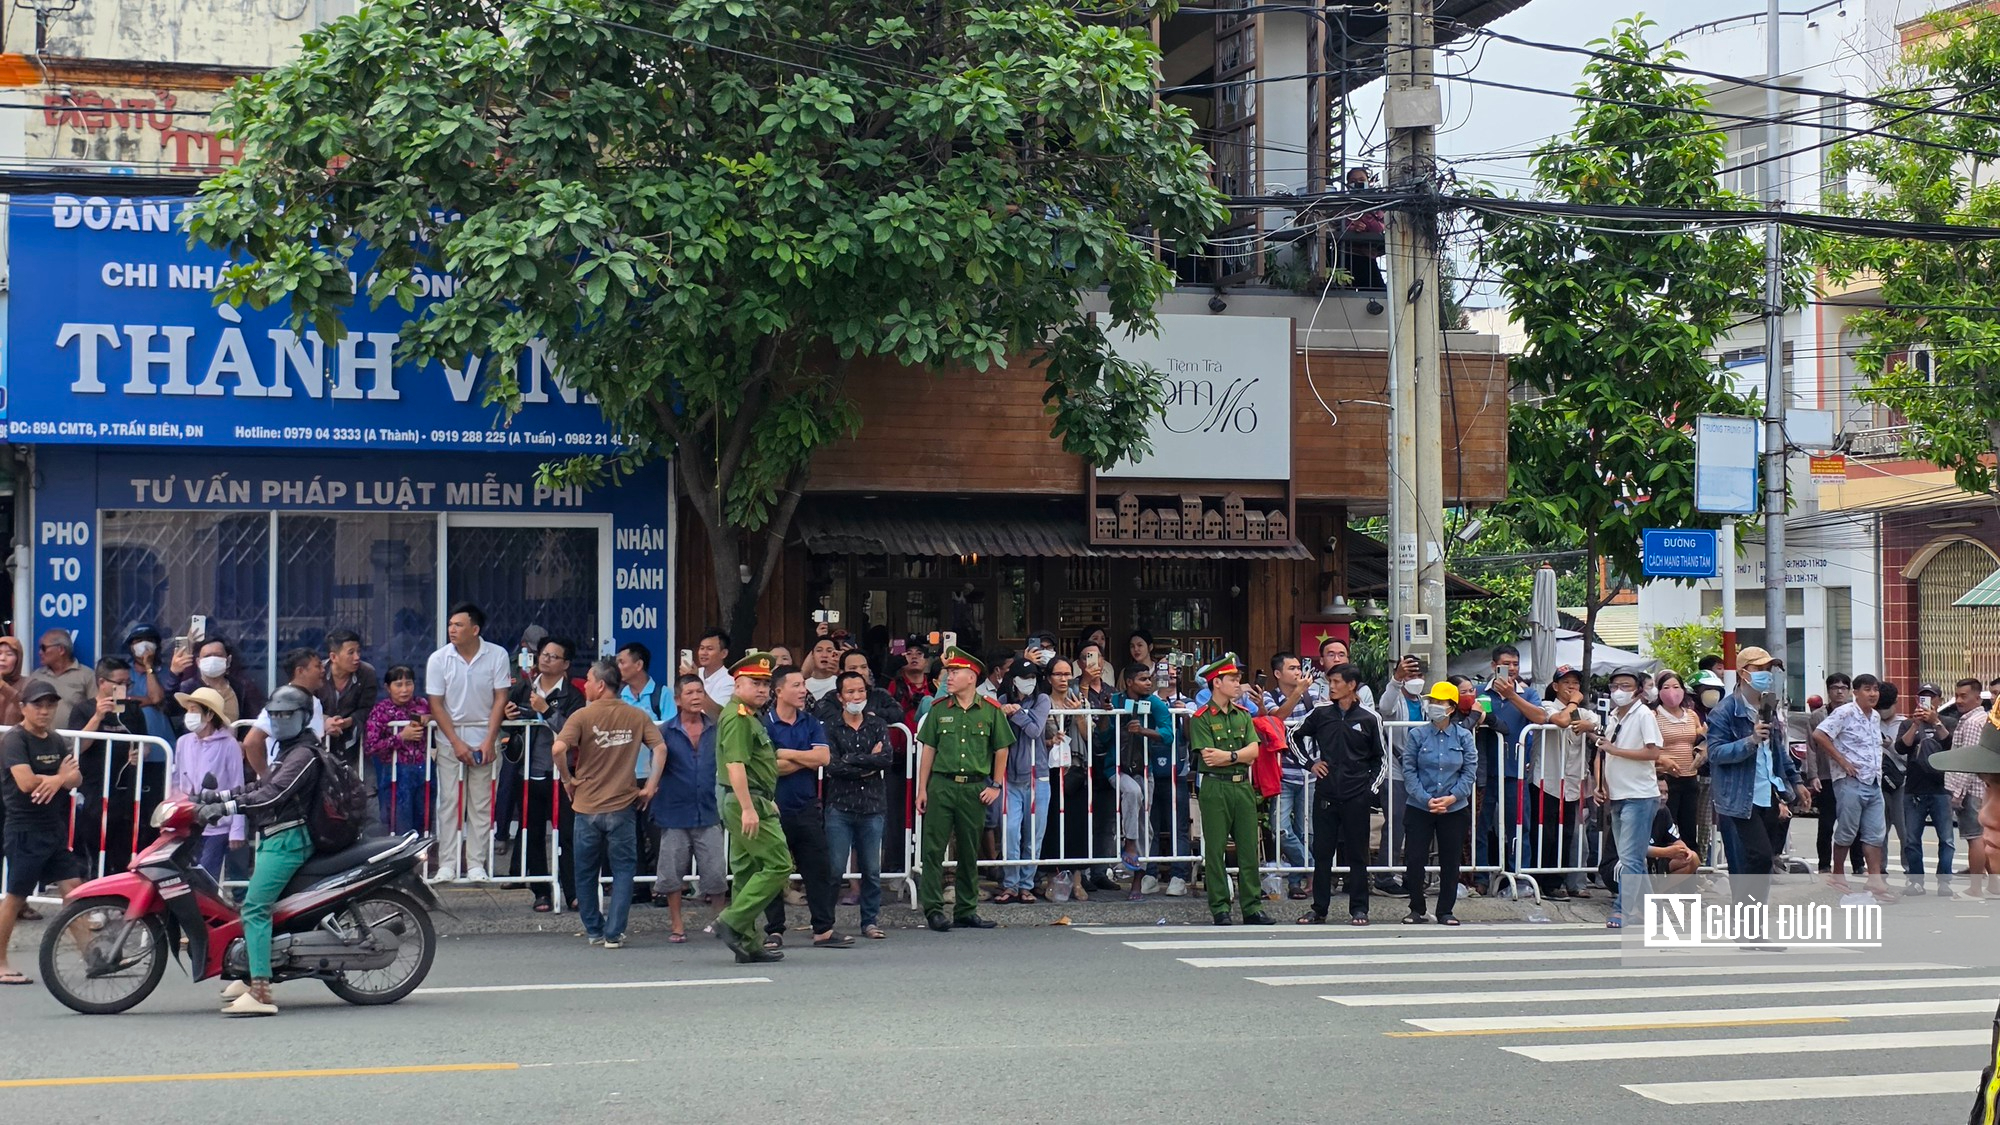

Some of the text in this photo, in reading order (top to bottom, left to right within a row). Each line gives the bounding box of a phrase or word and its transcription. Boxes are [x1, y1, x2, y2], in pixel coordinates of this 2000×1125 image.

[101, 260, 238, 289] CHI NHÁ
[55, 302, 400, 402] THÀNH
[1167, 358, 1222, 373] Tiệm Trà
[33, 421, 56, 435] 89A
[58, 422, 97, 438] CMT8,
[149, 424, 183, 440] BIÊN,
[185, 424, 204, 438] ĐN
[235, 426, 281, 439] Hotline:
[283, 427, 313, 440] 0979
[315, 428, 330, 440] 04
[333, 428, 361, 441] 3333
[364, 428, 377, 443] (A
[380, 429, 419, 444] Thành)
[430, 430, 459, 442] 0919
[461, 430, 482, 443] 288
[485, 431, 506, 443] 225
[508, 431, 521, 446] (A
[524, 430, 556, 446] Tuấn)
[565, 433, 592, 445] 0982
[594, 433, 607, 446] 21
[131, 475, 175, 503] TƯ
[184, 472, 251, 503] VẤN
[262, 475, 347, 504] PHÁP
[356, 477, 435, 510] LUẬT
[446, 472, 523, 506] MIỄN
[41, 522, 90, 545] PHO
[616, 524, 664, 555] NHẬN
[1664, 537, 1696, 548] ĐƯỜNG
[50, 558, 81, 581] TO
[1649, 553, 1711, 569] CÁCH MẠNG THÁNG TÁM
[616, 563, 664, 590] ĐÁNH
[40, 593, 88, 617] COP
[621, 603, 657, 629] ĐƠN
